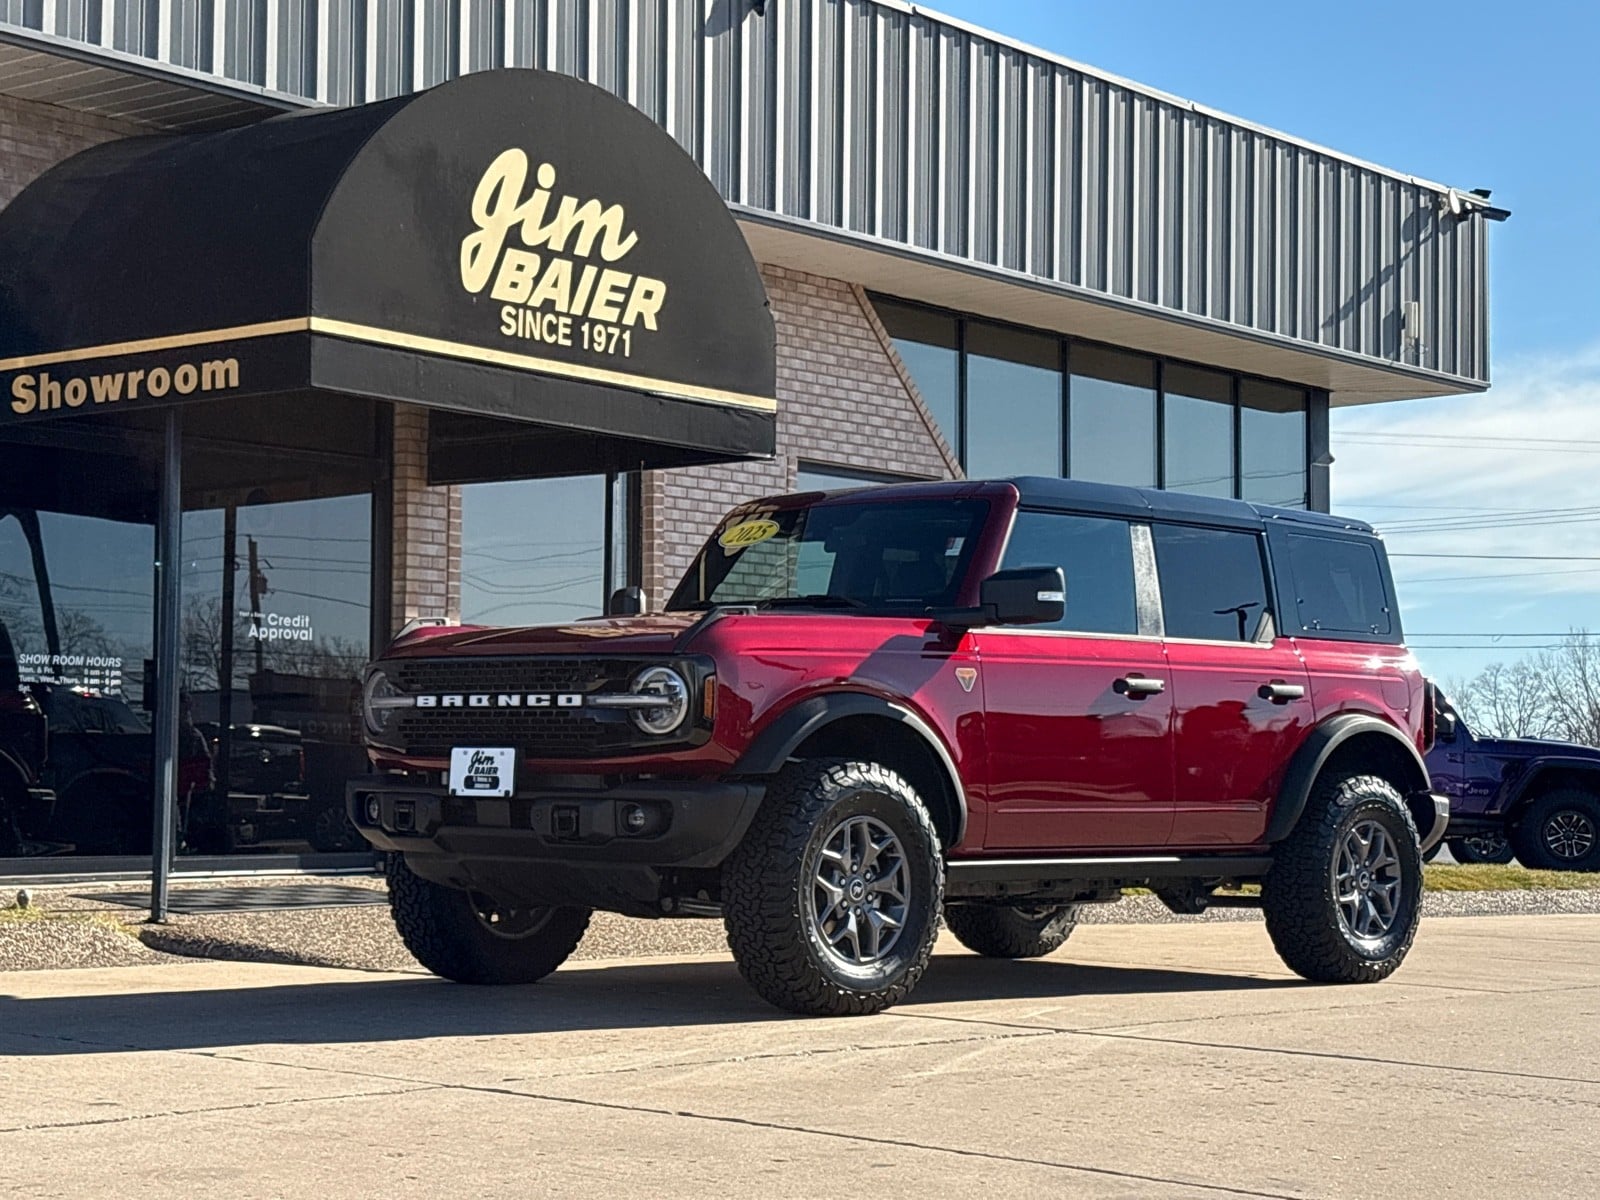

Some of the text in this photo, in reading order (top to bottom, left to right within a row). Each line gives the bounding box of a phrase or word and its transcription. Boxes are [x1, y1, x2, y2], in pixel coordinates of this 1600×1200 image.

[460, 147, 638, 294] Jim
[490, 247, 667, 331] BAIER
[500, 305, 631, 358] SINCE 1971
[11, 358, 239, 414] Showroom
[726, 524, 774, 544] 2025
[267, 613, 310, 628] Credit
[248, 623, 313, 642] Approval
[19, 653, 122, 668] SHOW ROOM HOURS
[416, 694, 583, 708] BRONCO
[467, 750, 495, 775] Jim
[473, 766, 499, 775] BAIER
[1467, 787, 1489, 796] Jeep
